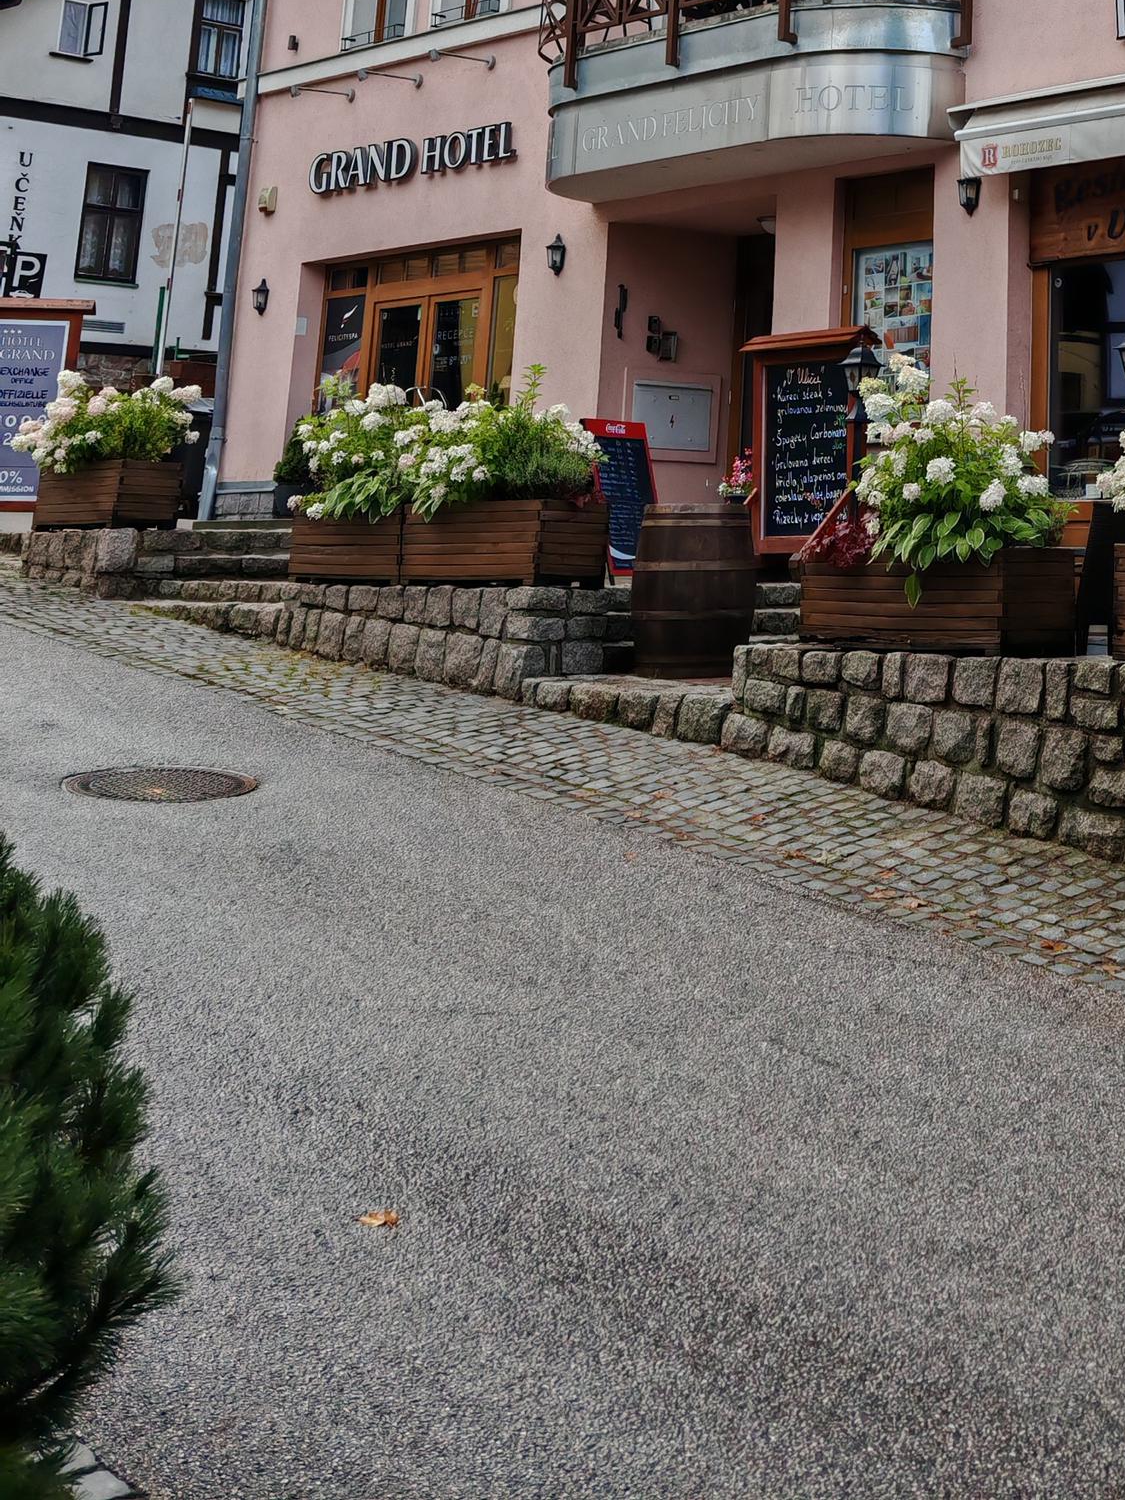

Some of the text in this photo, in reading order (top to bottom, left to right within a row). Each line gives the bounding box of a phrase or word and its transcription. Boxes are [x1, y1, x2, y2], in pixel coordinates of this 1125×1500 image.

[582, 116, 656, 152] GRAND
[663, 94, 761, 137] FELICITY
[795, 85, 914, 113] HOTEL
[309, 138, 418, 194] GRAND
[421, 121, 516, 174] HOTEL
[12, 255, 41, 288] P
[1, 336, 41, 347] HOTEL
[0, 348, 55, 360] GRAND
[0, 366, 51, 377] EXCHANGE
